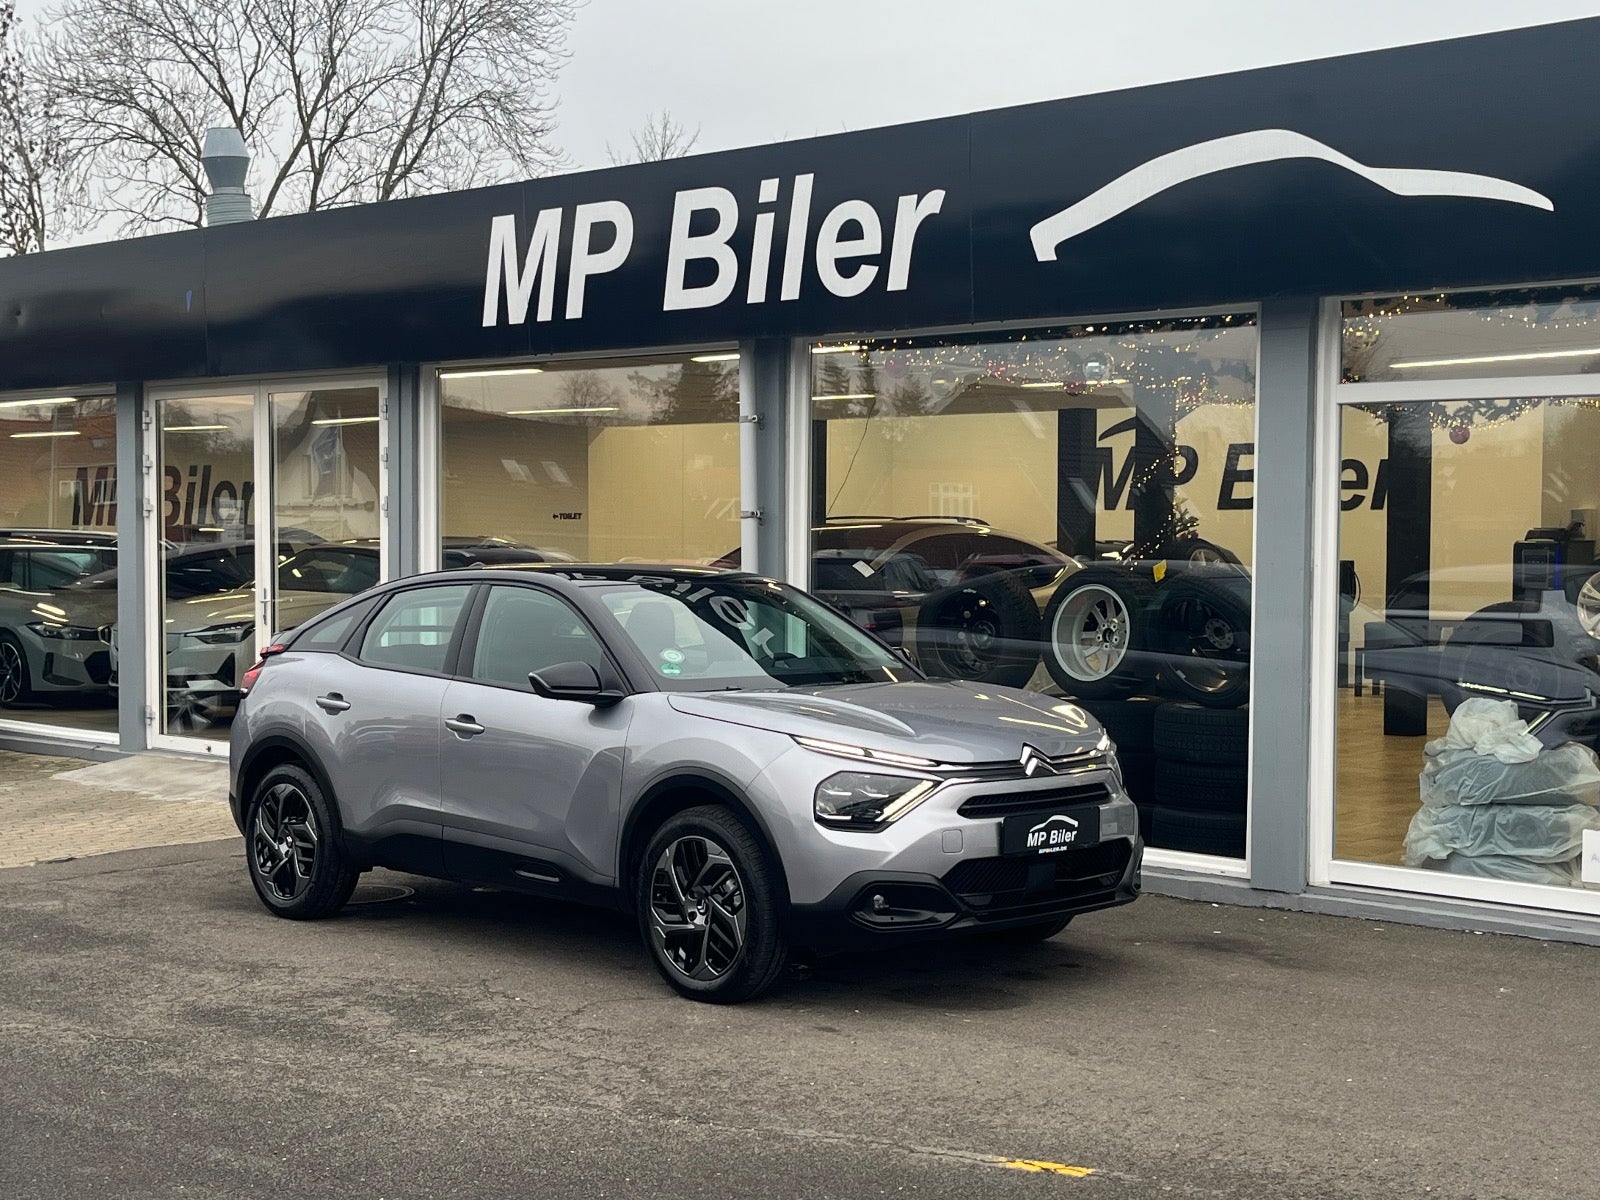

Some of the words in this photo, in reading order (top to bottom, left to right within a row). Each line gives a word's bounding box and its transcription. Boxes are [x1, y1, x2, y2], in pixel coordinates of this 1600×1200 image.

[482, 200, 634, 327] MP
[663, 173, 946, 311] Biler
[559, 512, 582, 520] TOILET
[1026, 831, 1047, 847] MP
[1049, 829, 1077, 844] Biler
